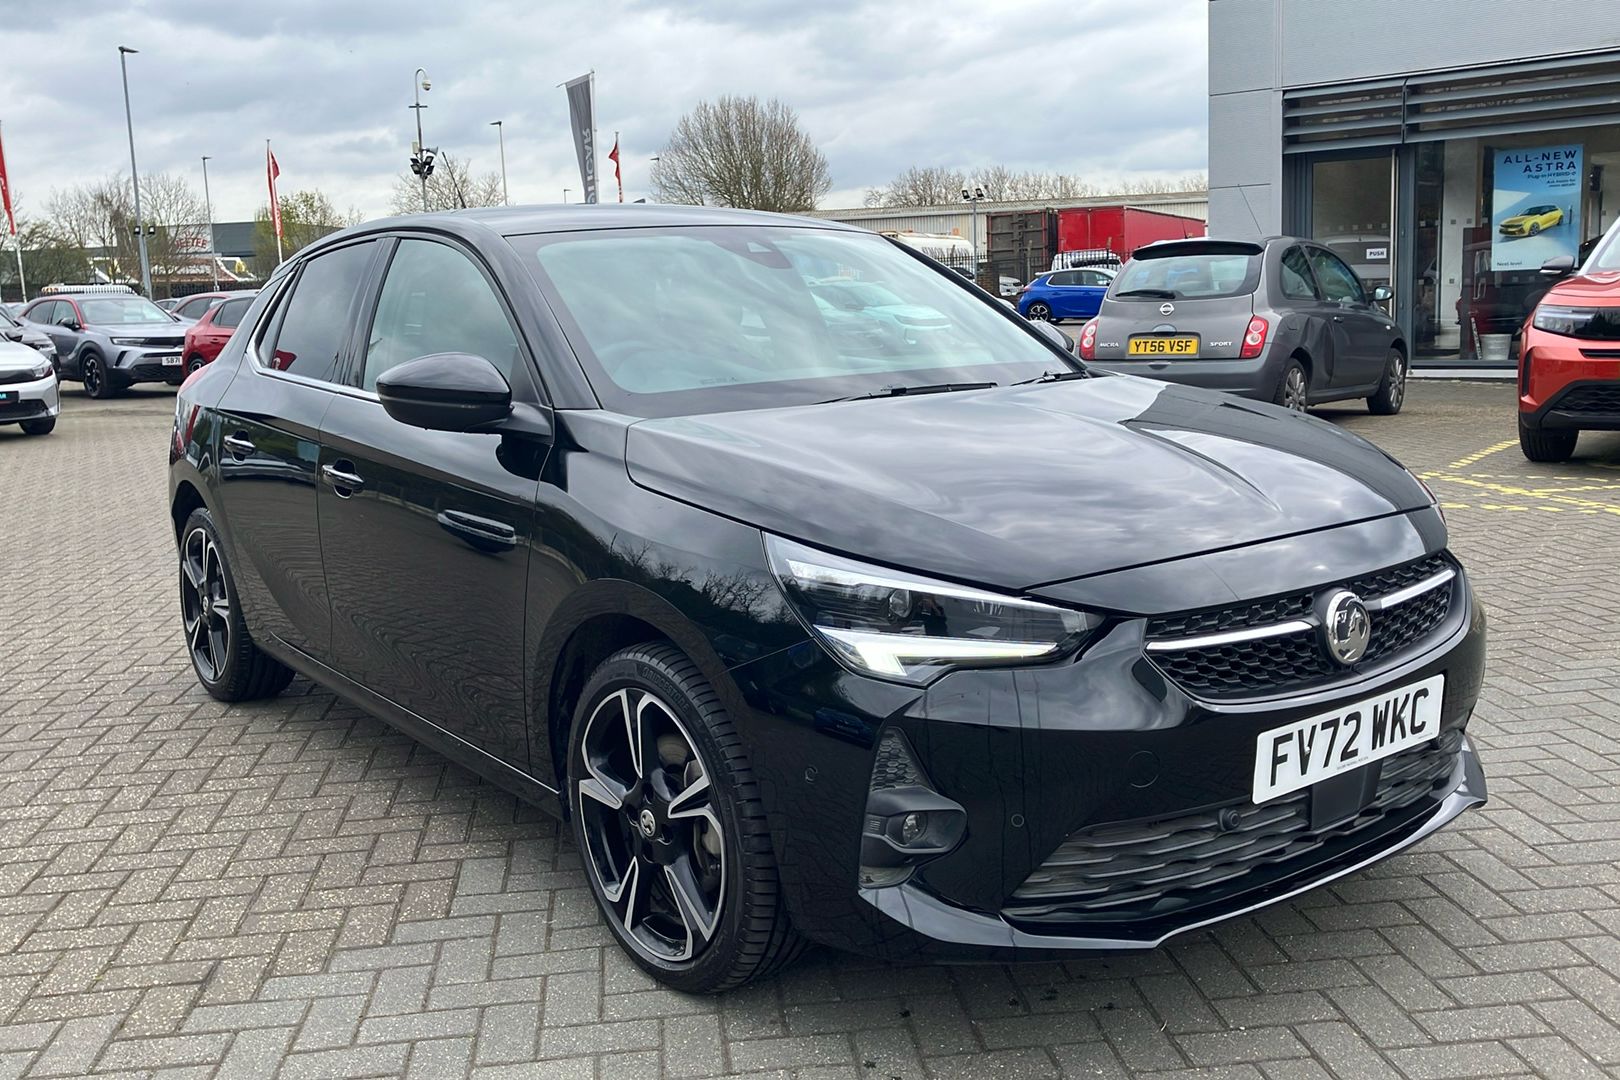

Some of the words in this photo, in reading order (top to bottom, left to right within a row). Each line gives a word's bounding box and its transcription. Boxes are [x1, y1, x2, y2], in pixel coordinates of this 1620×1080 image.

[1503, 150, 1577, 164] ALL-NEW
[1523, 161, 1577, 173] ASTRA
[1135, 341, 1165, 353] YT56
[1169, 340, 1193, 352] VSF
[1270, 711, 1362, 787] FV72
[1371, 687, 1430, 751] WKC
